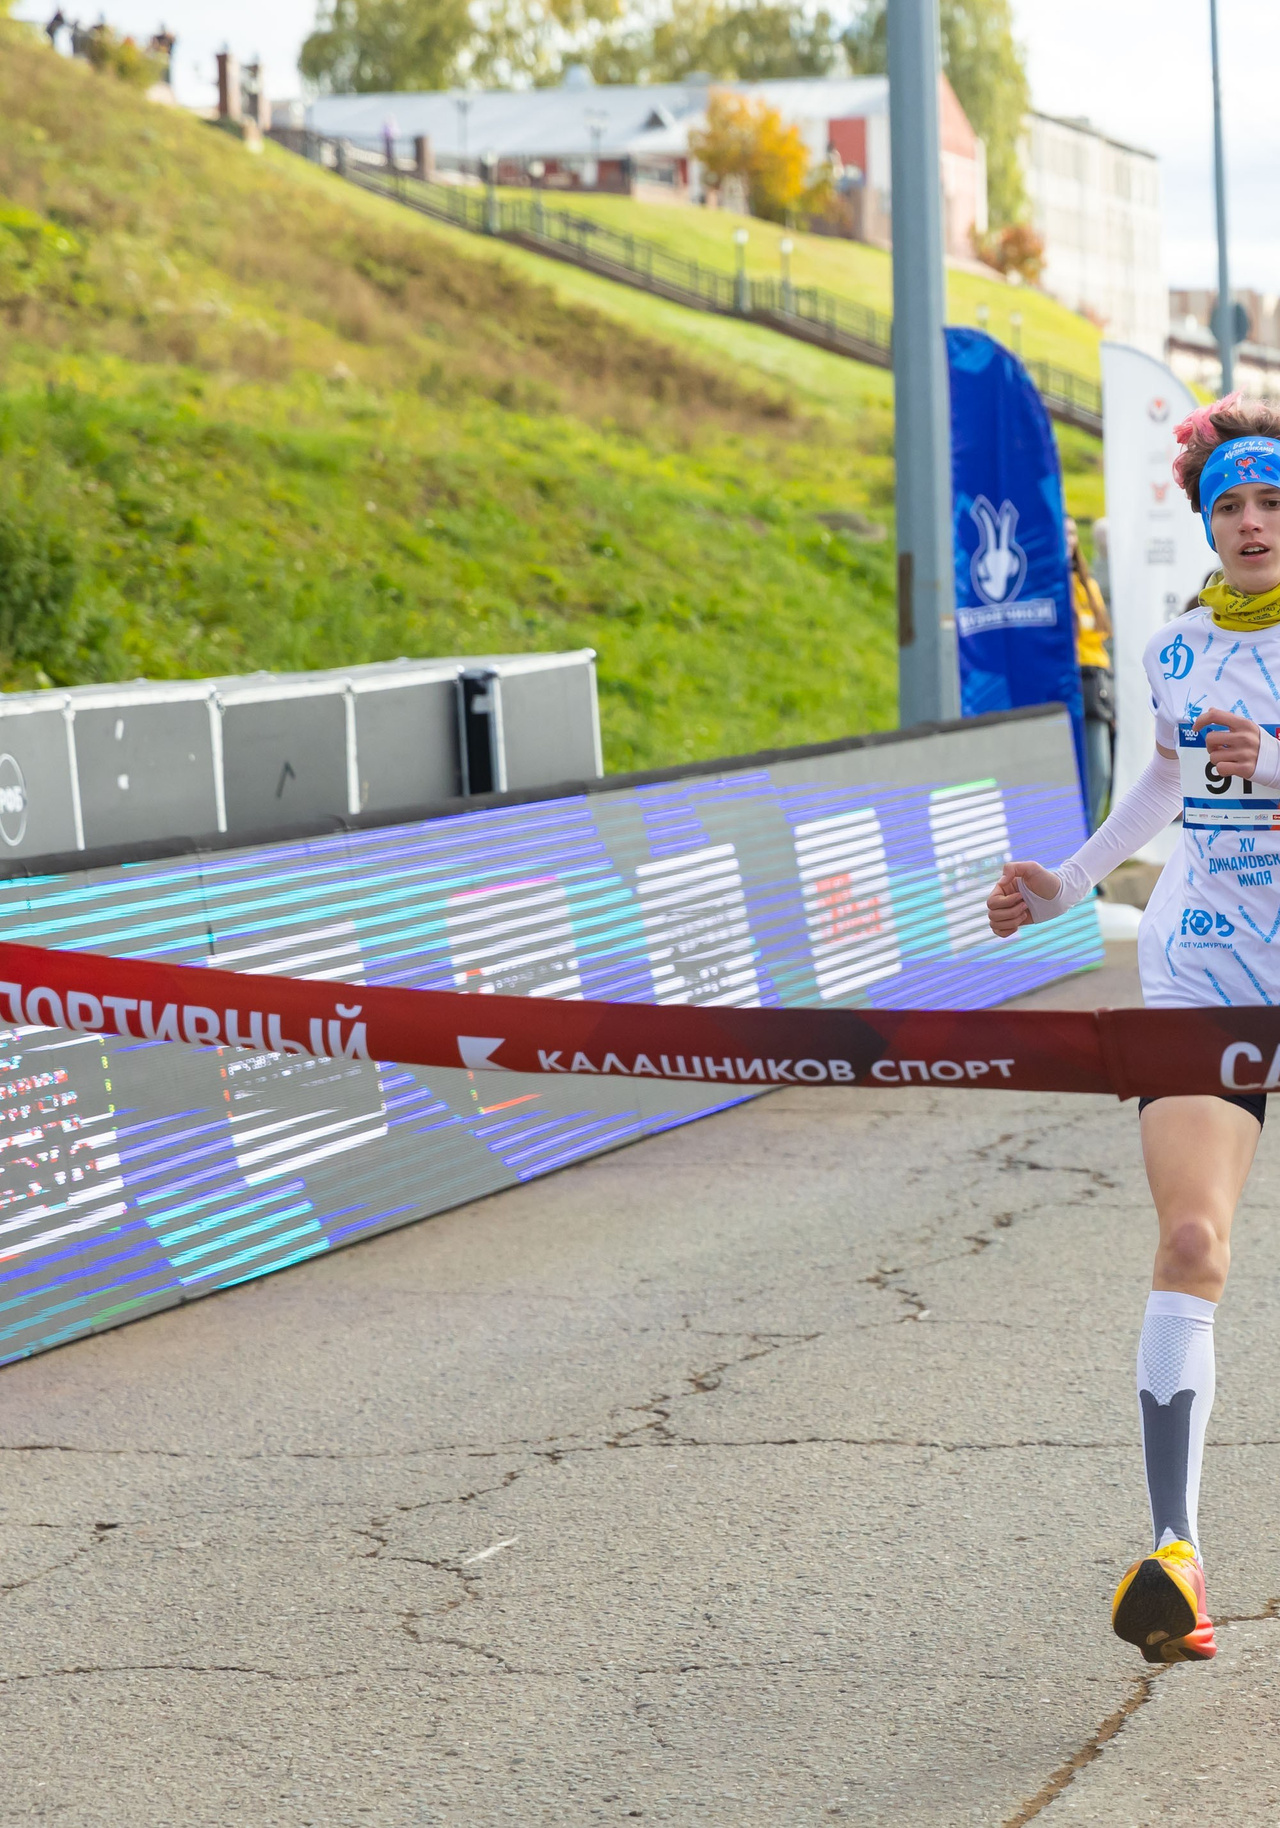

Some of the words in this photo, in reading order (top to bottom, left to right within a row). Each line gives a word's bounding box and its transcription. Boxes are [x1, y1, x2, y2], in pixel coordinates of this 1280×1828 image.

[1237, 870, 1273, 887] МИЛЯ
[1192, 942, 1233, 950] УДМУРТИИ
[537, 1049, 856, 1083] КАЛАШНИКОВ
[870, 1058, 1015, 1082] СПОРТ
